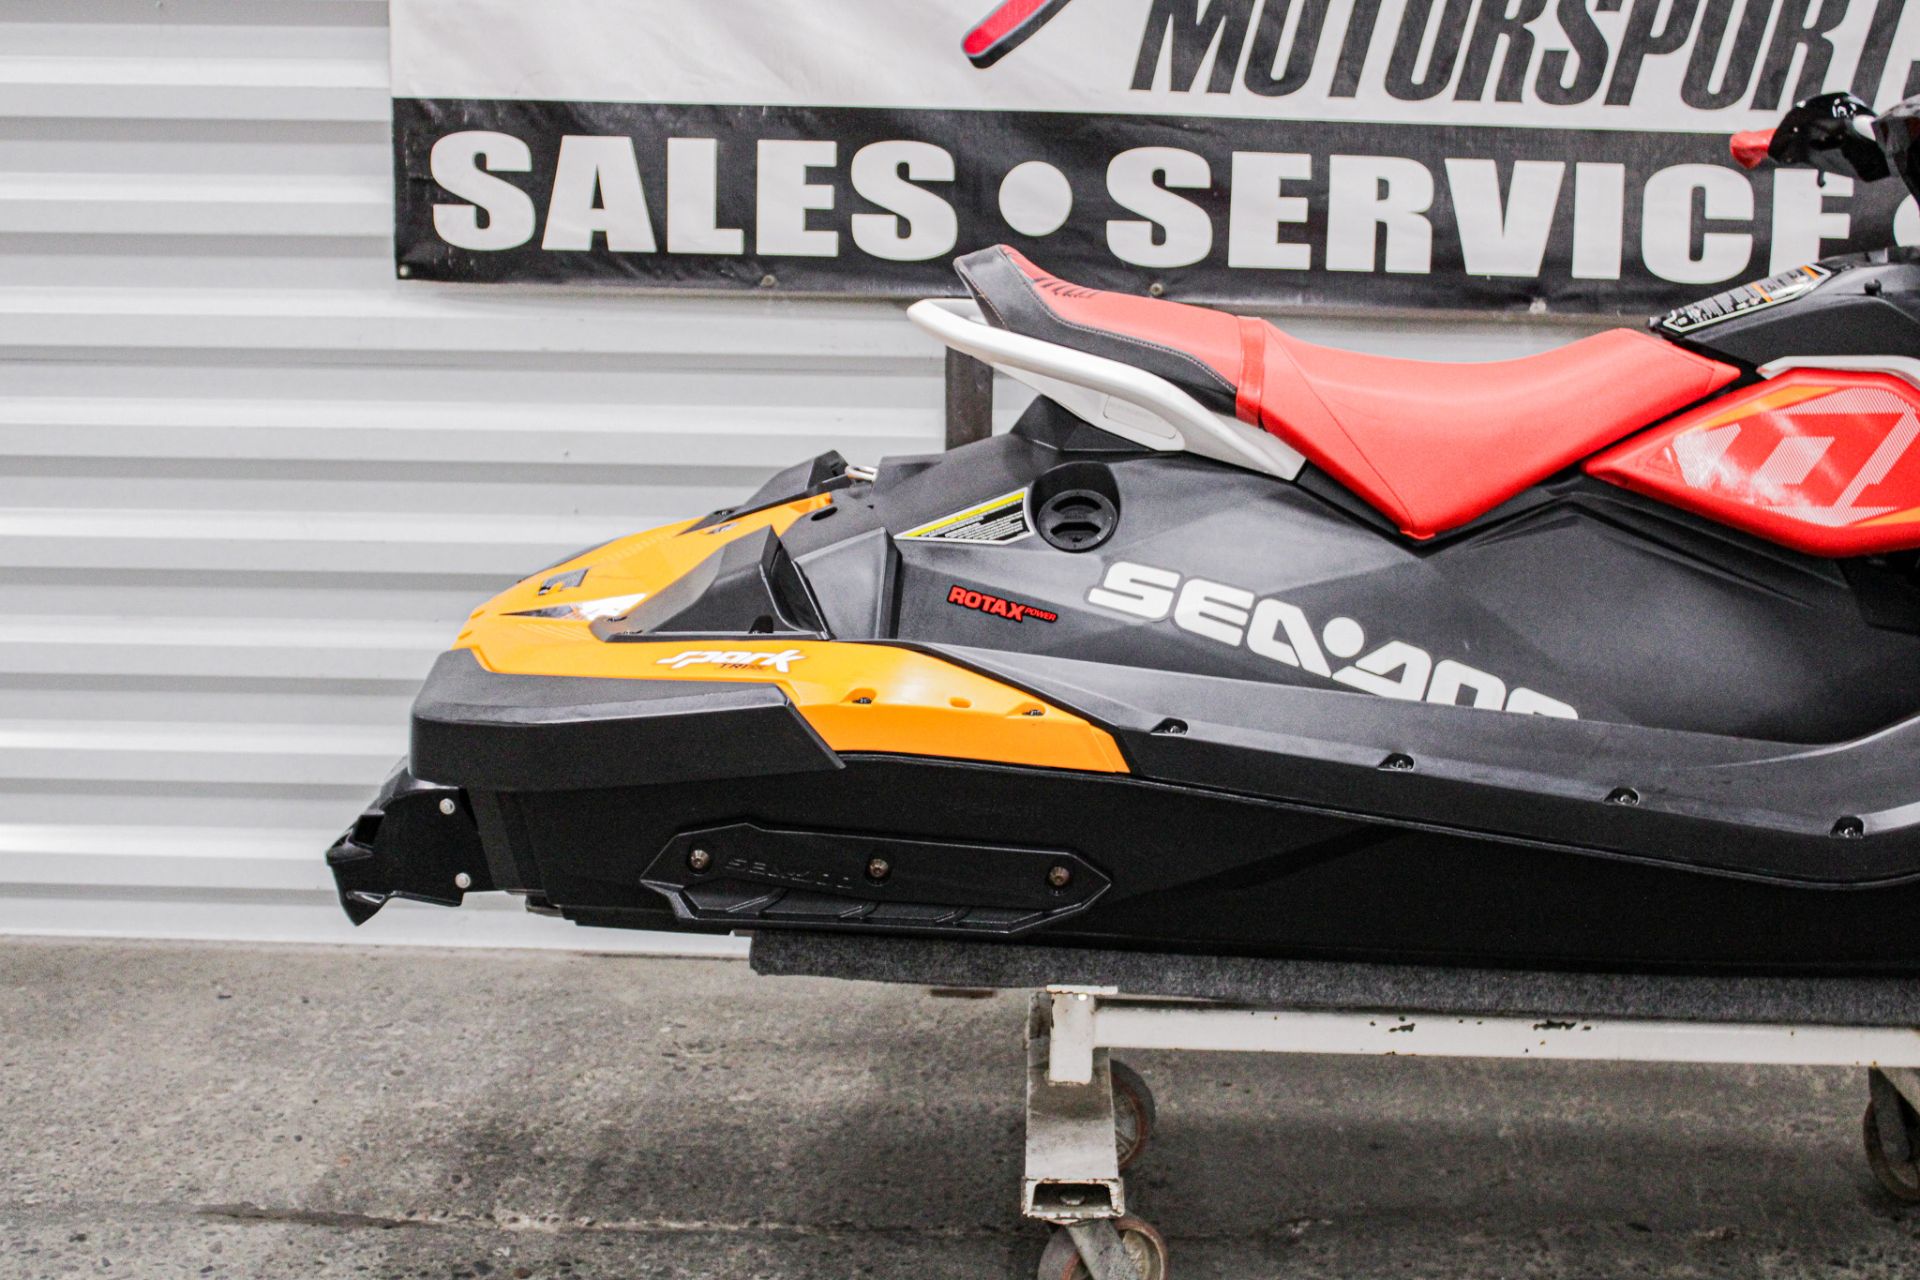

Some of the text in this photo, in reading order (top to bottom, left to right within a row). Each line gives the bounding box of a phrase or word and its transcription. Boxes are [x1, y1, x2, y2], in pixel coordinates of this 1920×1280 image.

[1130, 0, 1920, 113] MOTORSPORT
[429, 130, 1854, 284] SALES SERVICE
[947, 585, 1058, 622] ROTAX POWER
